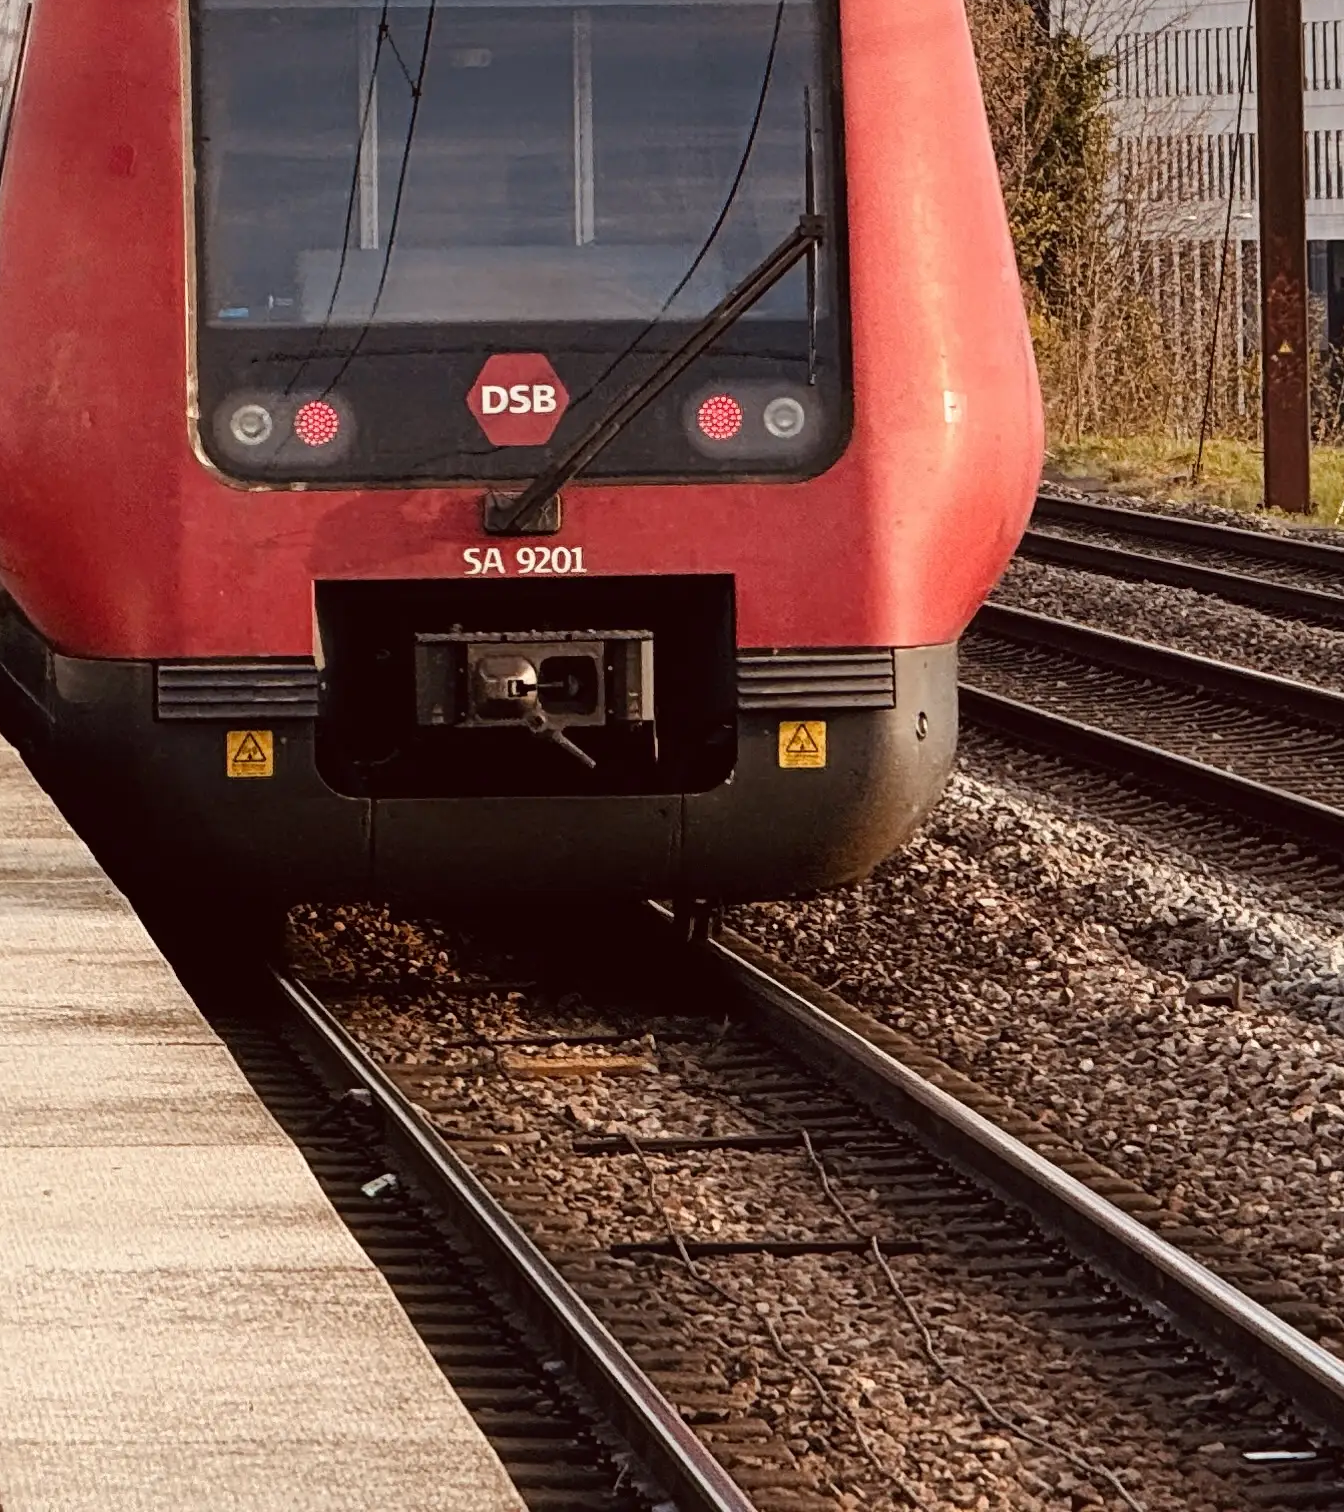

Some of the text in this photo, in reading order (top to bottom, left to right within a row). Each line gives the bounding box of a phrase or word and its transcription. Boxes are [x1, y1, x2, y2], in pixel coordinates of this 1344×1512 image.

[482, 384, 557, 415] DSB
[463, 546, 588, 575] SA 9201
